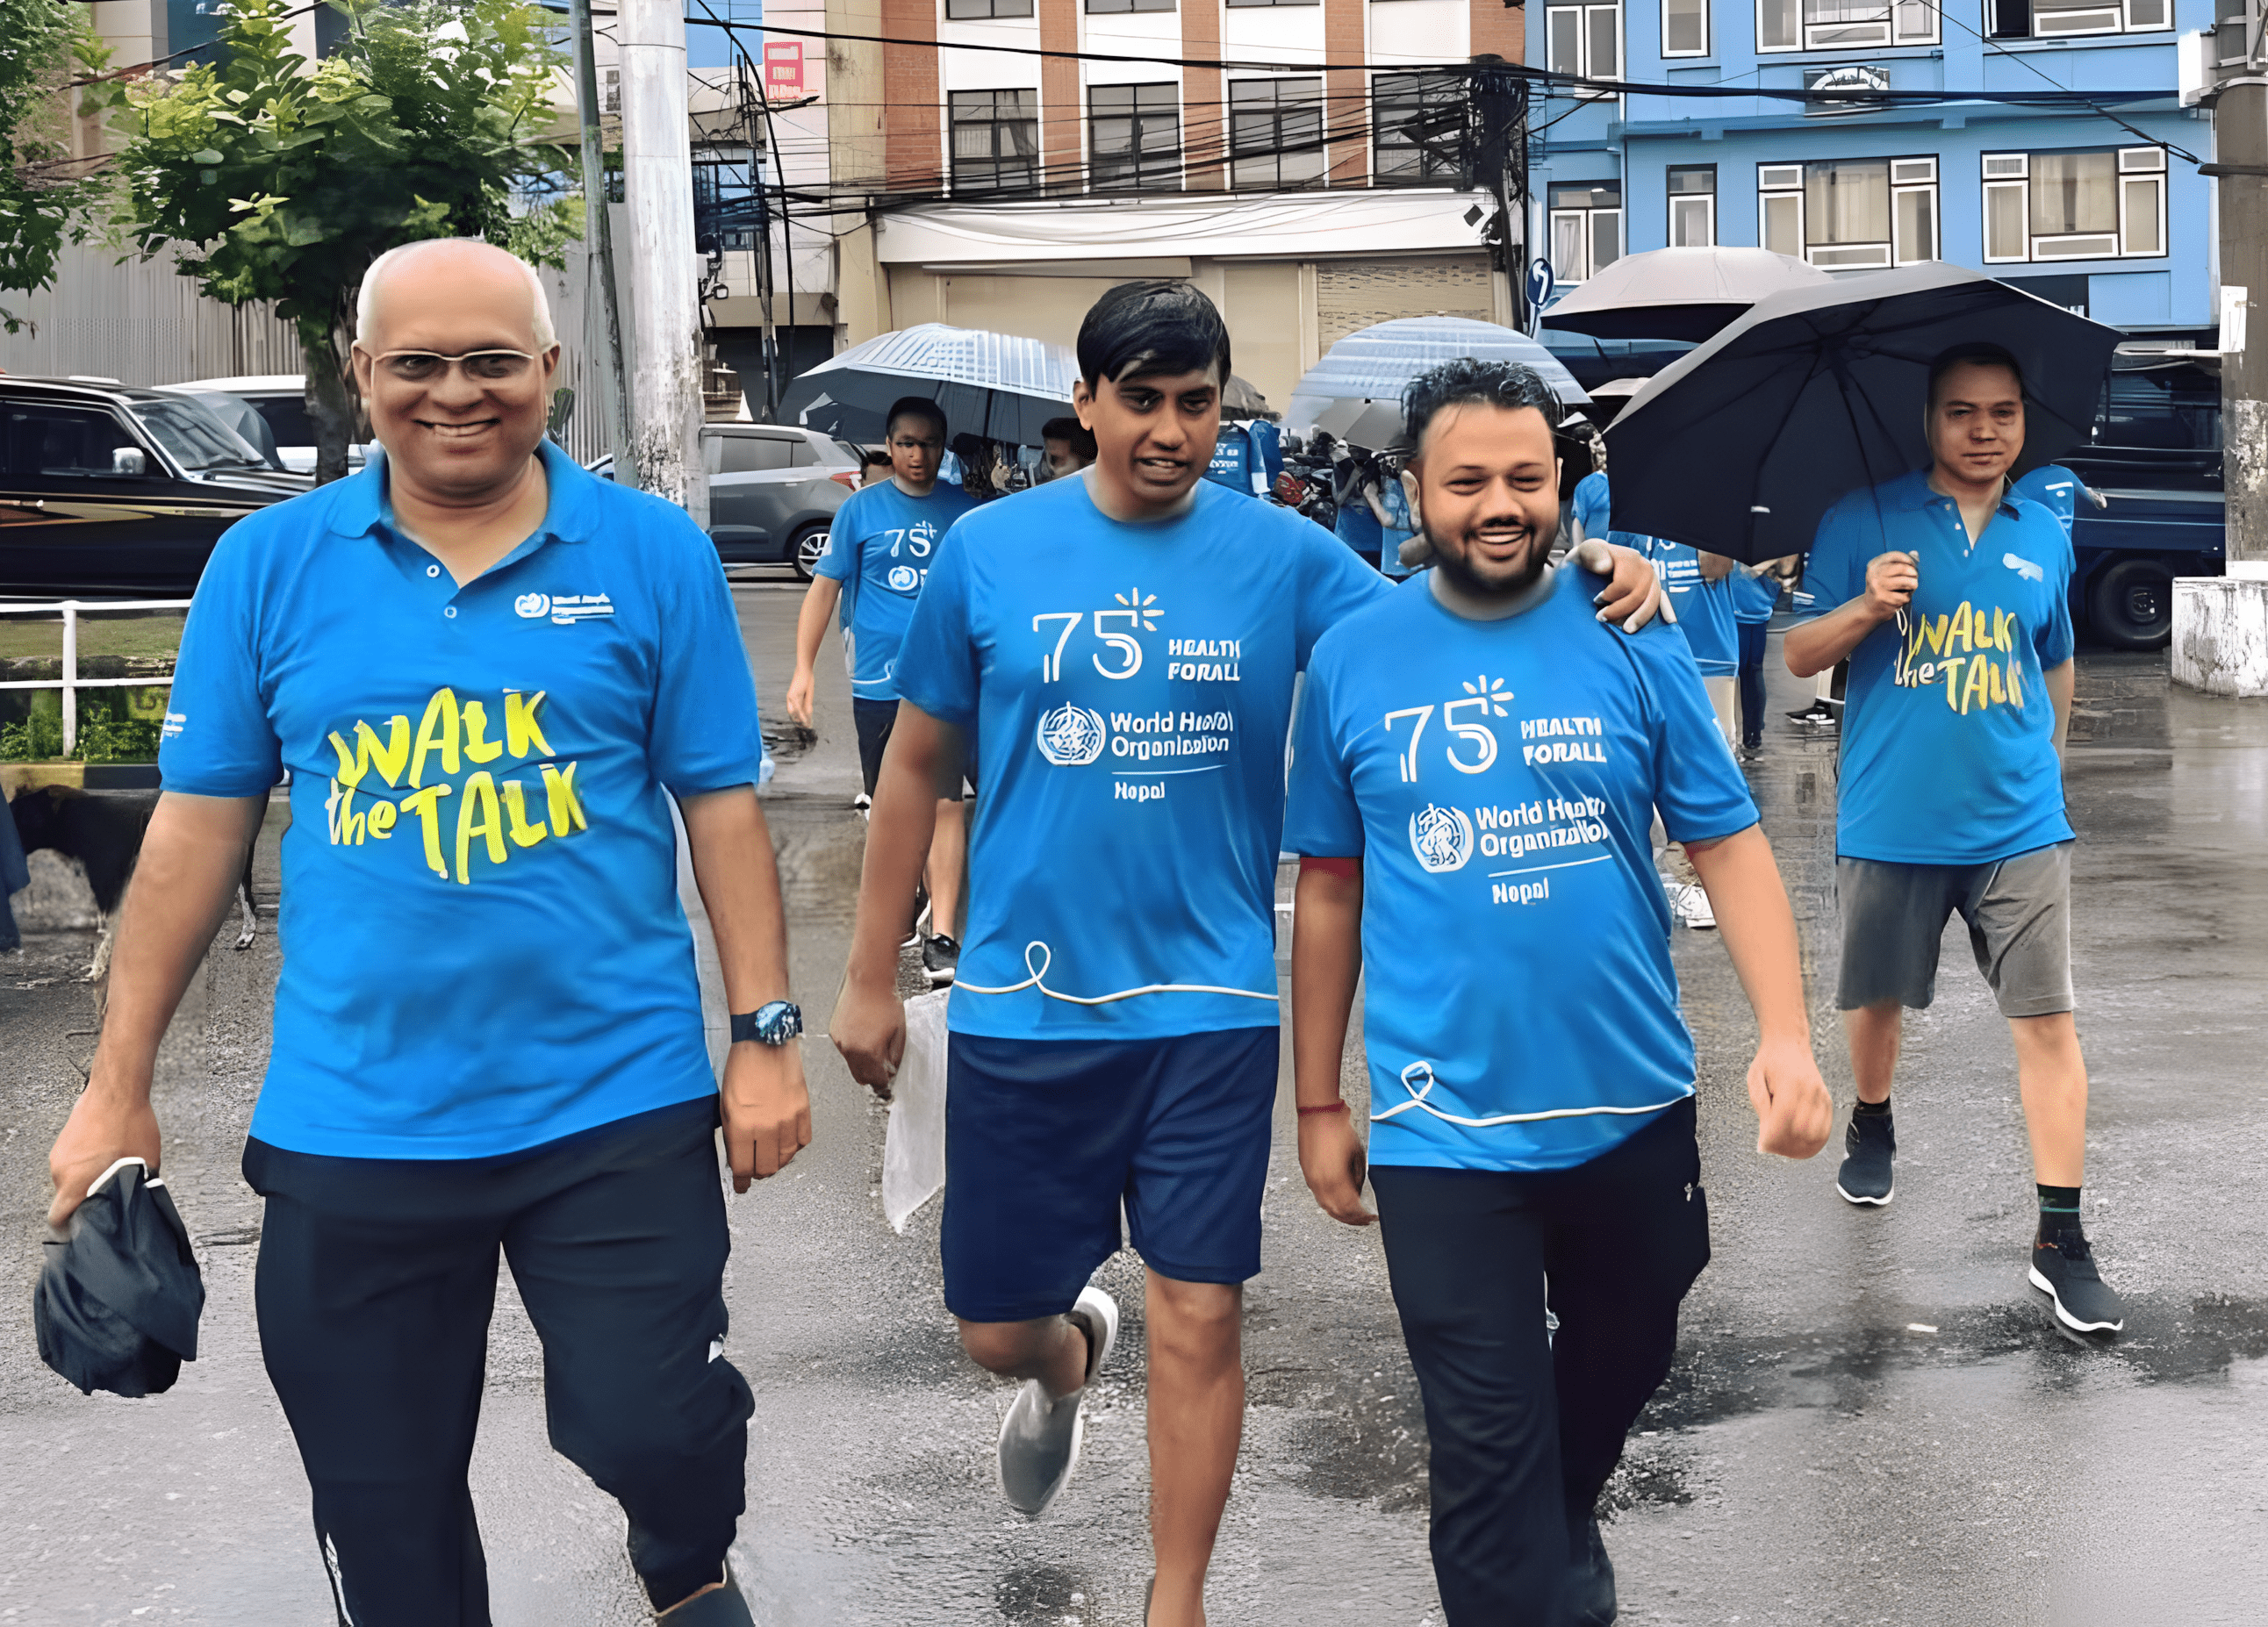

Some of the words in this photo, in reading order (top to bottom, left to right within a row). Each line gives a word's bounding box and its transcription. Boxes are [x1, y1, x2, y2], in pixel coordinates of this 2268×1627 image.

[1032, 609, 1144, 684] 75
[1908, 600, 2015, 657] WALK
[327, 687, 556, 790] WALK
[1110, 711, 1174, 733] World
[1384, 697, 1498, 783] 75
[325, 777, 397, 845] the
[399, 761, 588, 885] TALK
[1475, 800, 1543, 830] World
